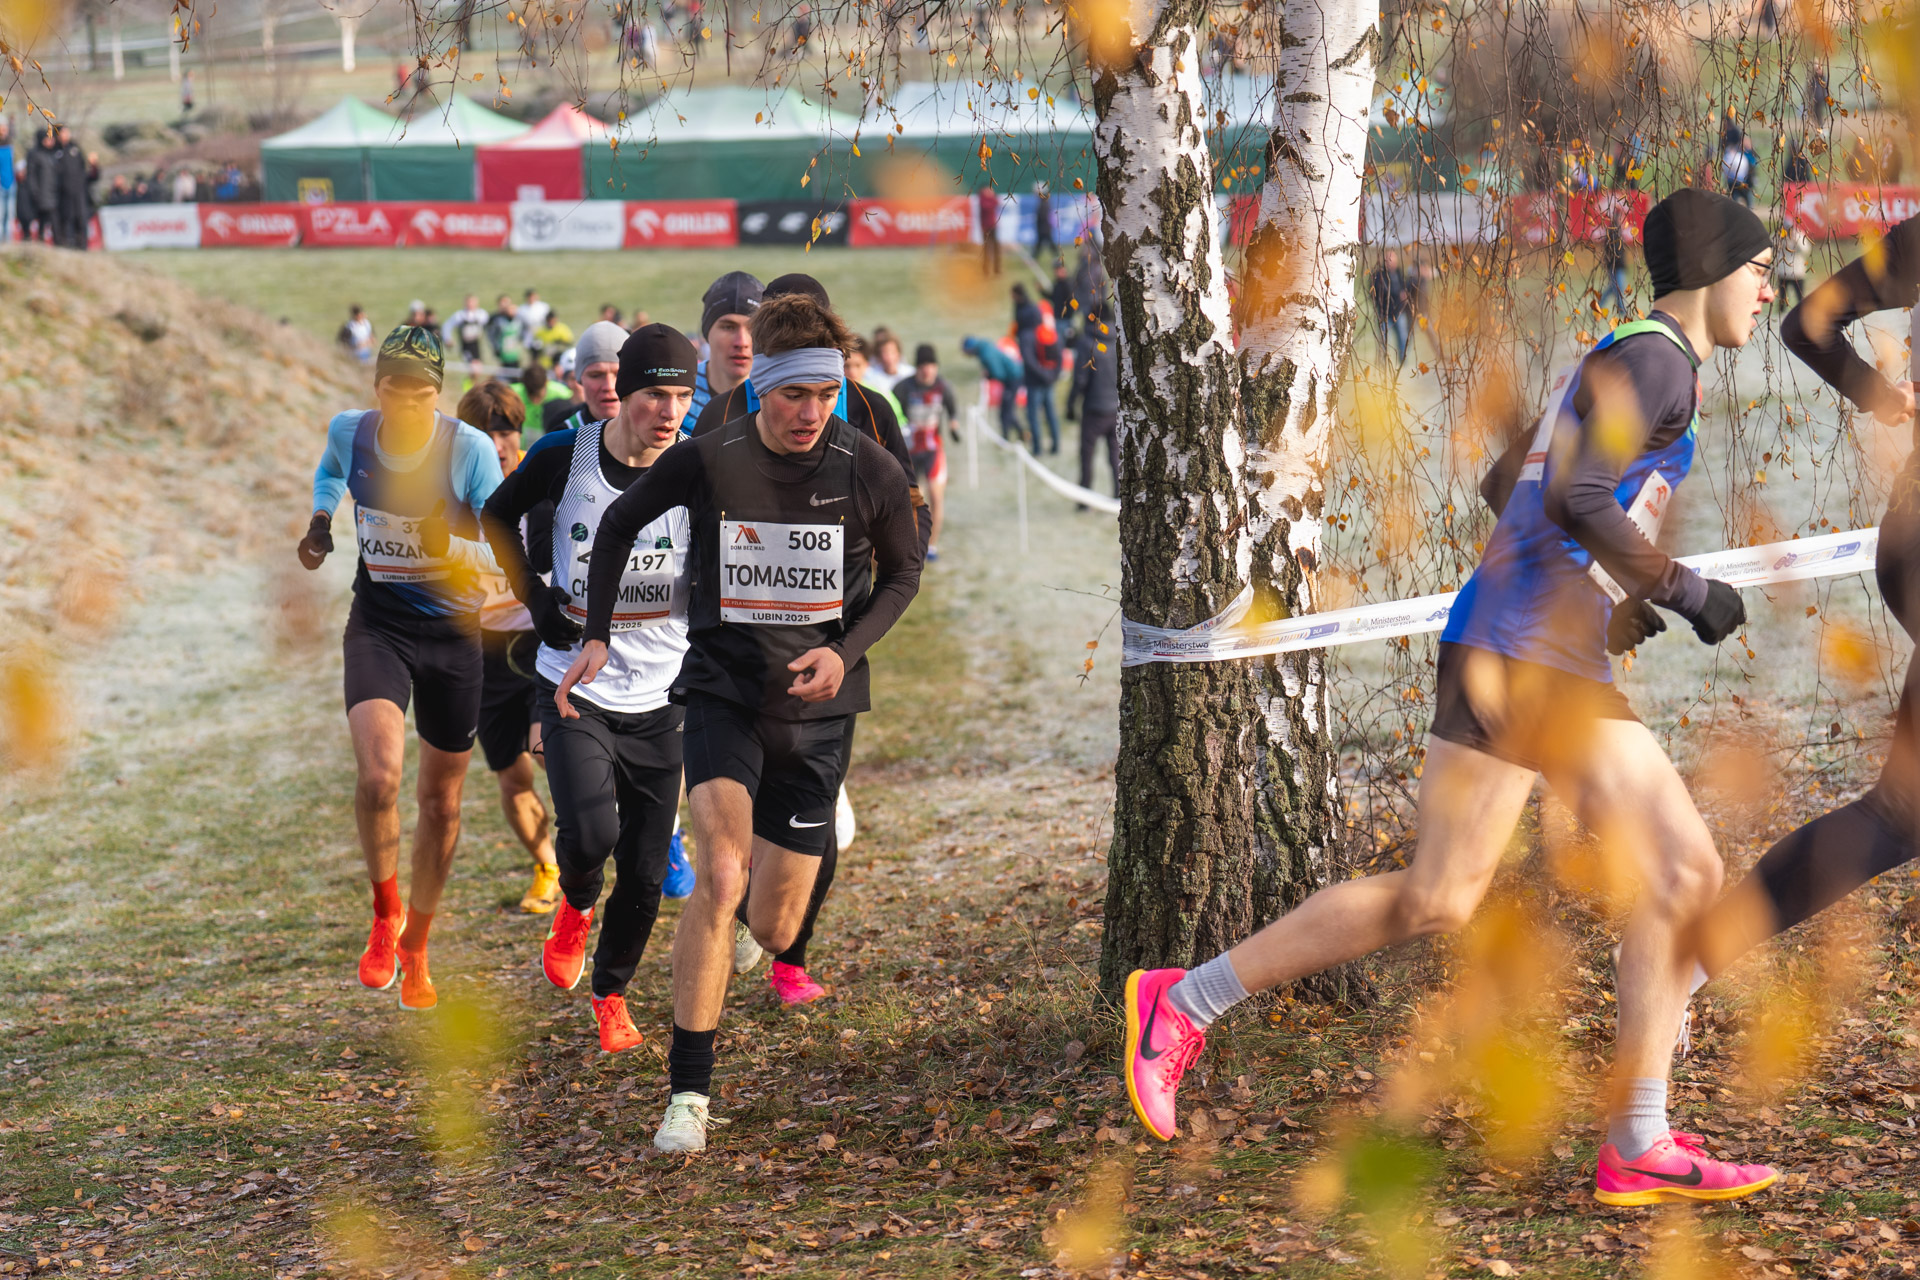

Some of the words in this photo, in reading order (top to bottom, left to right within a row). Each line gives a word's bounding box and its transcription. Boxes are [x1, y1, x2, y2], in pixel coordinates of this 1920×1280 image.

[236, 212, 298, 234] ORLEN
[311, 207, 392, 234] PZLA
[443, 212, 508, 235] ORLEN
[663, 212, 731, 236] ORLEN
[366, 513, 389, 526] RCS
[788, 531, 832, 551] 508
[630, 553, 667, 571] 197
[725, 564, 838, 590] TOMASZEK
[752, 612, 783, 621] LUBIN
[785, 613, 811, 622] 2025
[1370, 615, 1411, 625] Ministerstwo
[1153, 640, 1210, 650] Ministerstwo
